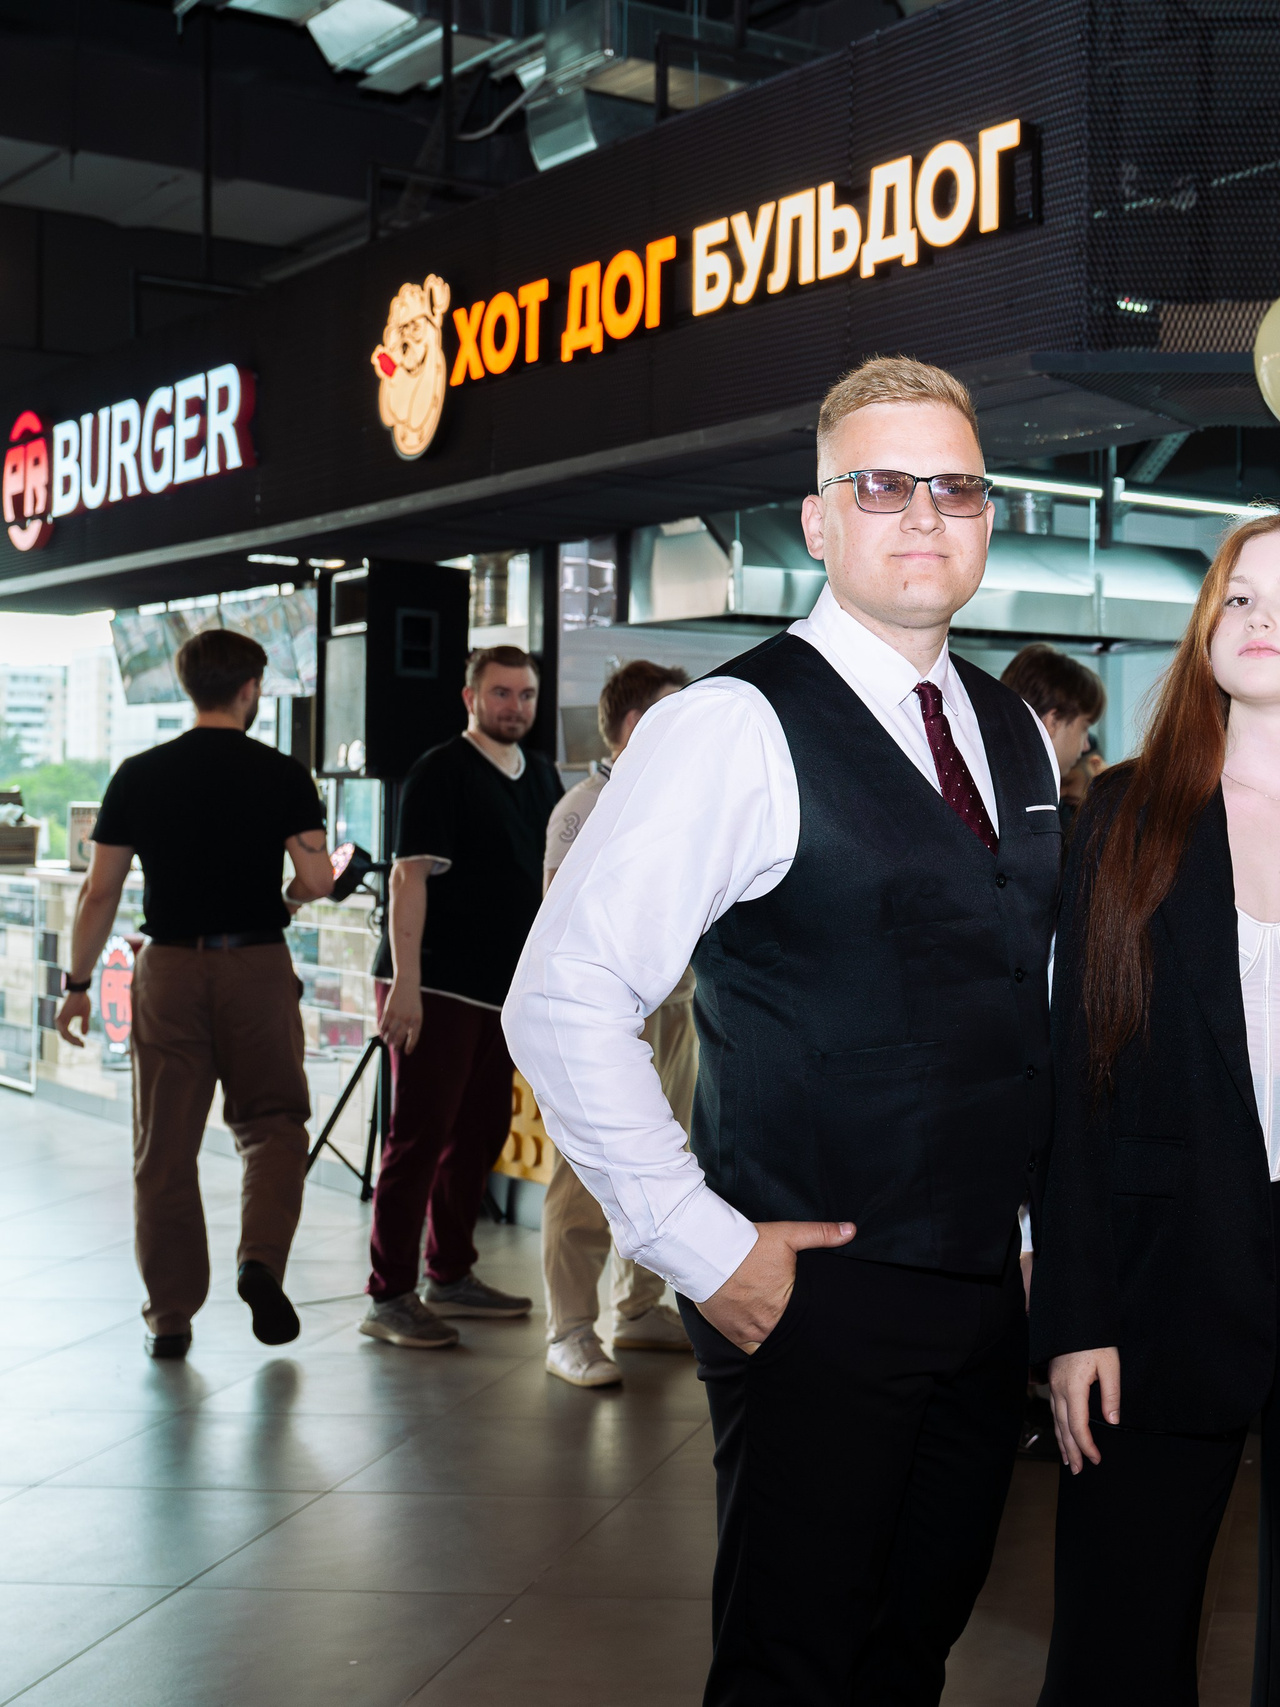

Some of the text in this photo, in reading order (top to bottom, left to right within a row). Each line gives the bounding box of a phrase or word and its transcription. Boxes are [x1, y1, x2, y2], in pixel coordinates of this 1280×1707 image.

[450, 118, 1021, 387] ХОТ ДОГ БУЛЬДОГ
[51, 362, 244, 519] BURGER
[560, 811, 580, 842] 3
